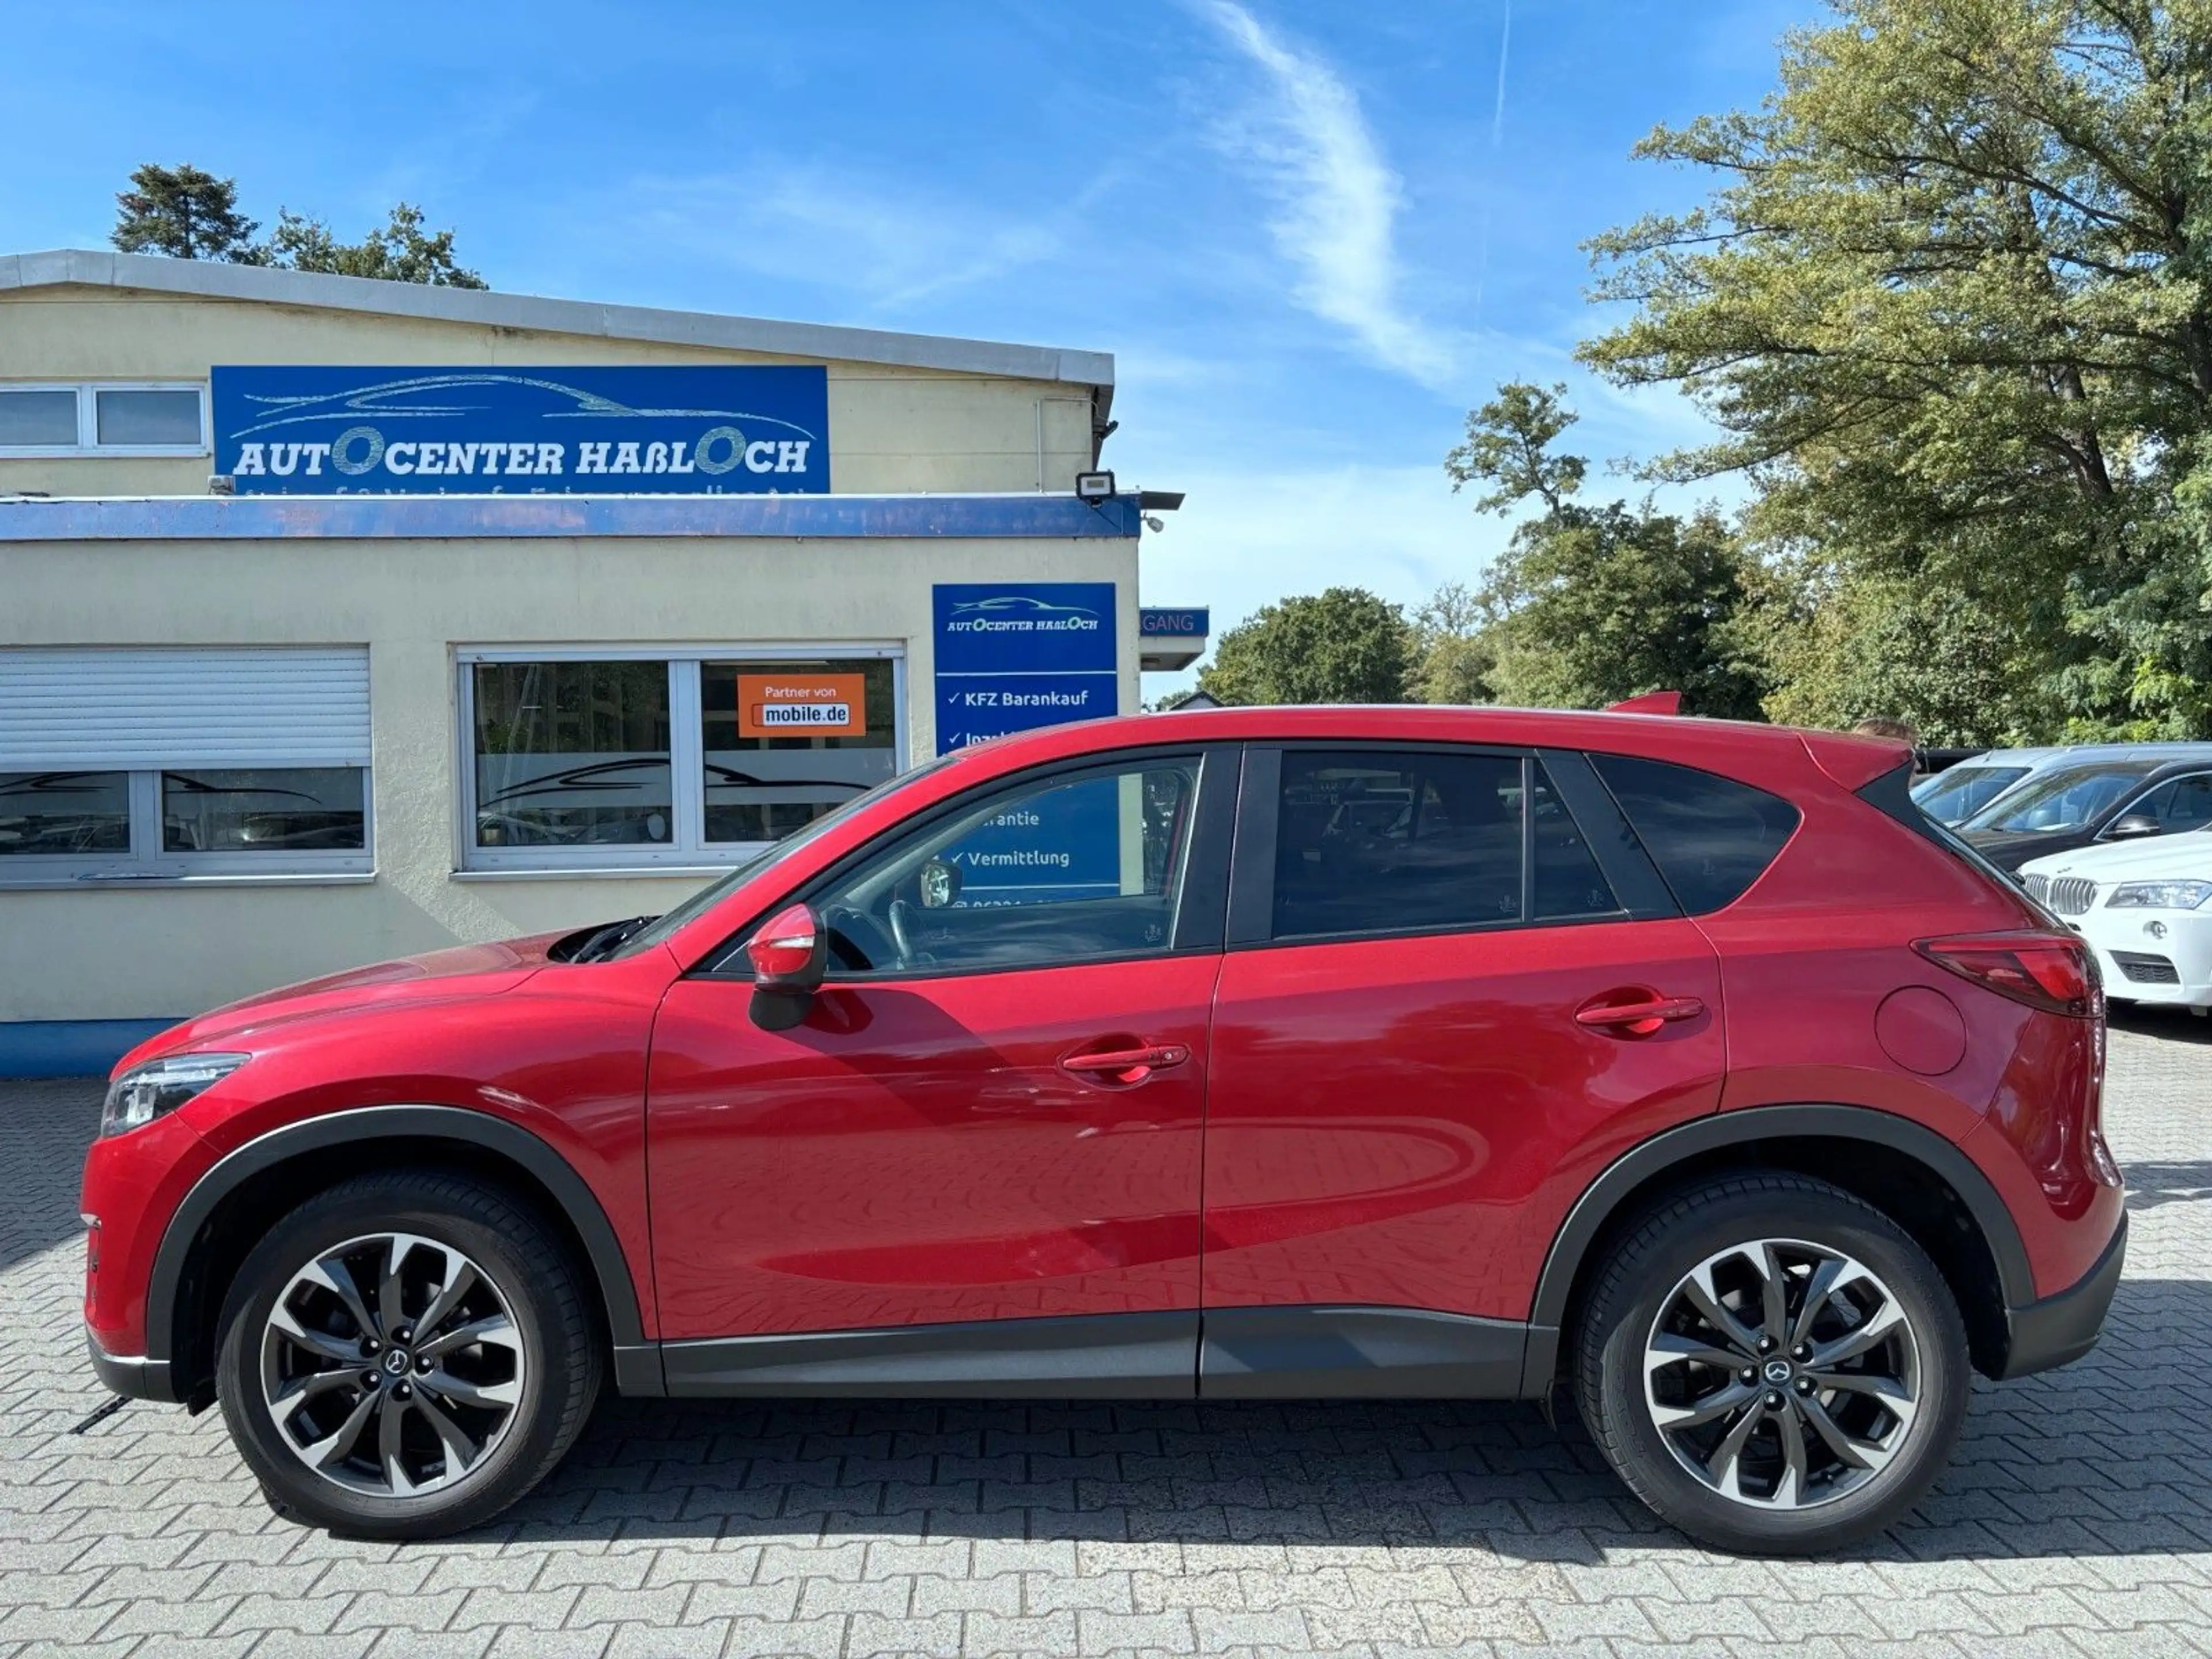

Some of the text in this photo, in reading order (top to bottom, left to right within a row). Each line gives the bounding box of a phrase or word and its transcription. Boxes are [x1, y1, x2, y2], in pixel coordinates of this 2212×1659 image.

[233, 426, 810, 476] AUTOCENTER HAßLOCH
[947, 618, 1033, 632] AUTOCENTER
[765, 687, 837, 698] Partner von
[965, 690, 1089, 706] KFZ Barankauf
[766, 706, 846, 721] mobile.de
[968, 850, 1070, 868] Vermittlung
